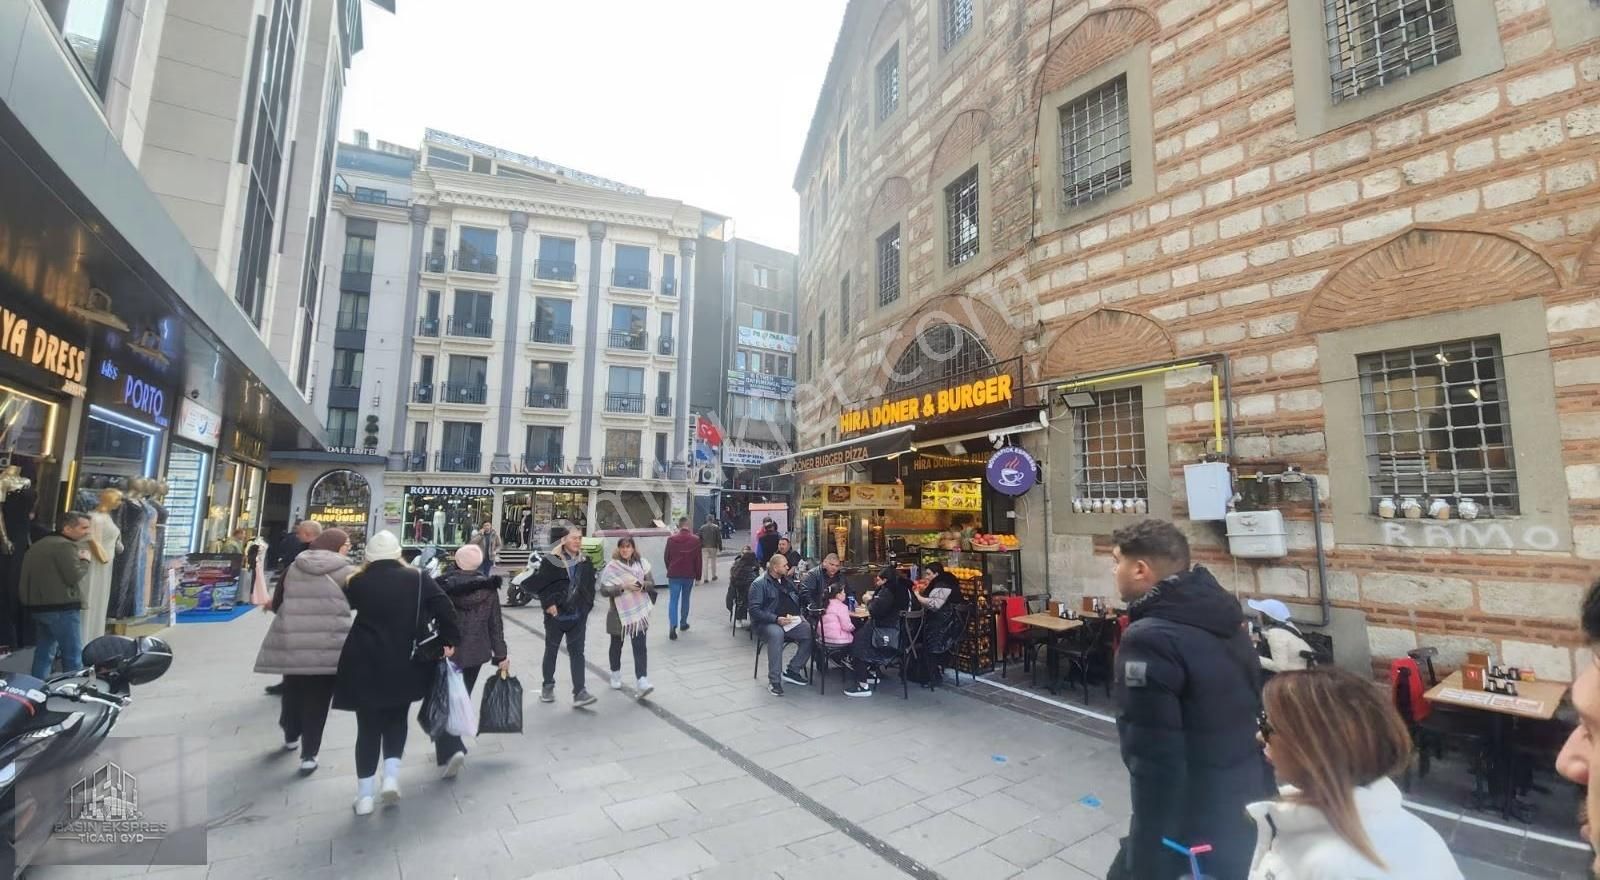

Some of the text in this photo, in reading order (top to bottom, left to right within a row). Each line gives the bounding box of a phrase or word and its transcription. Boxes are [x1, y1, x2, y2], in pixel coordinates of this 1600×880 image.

[0, 305, 86, 382] YA DRESS
[124, 374, 163, 416] PORTO
[840, 374, 1012, 433] HİRA DÖNER & BURGER
[327, 446, 347, 454] DAR
[815, 451, 843, 468] BURGER
[845, 446, 869, 463] PİZZA
[914, 456, 932, 471] HİRA
[410, 486, 449, 495] ROYMA
[501, 475, 590, 487] HOTEL PİYA SPORT
[1382, 521, 1560, 550] RAMO
